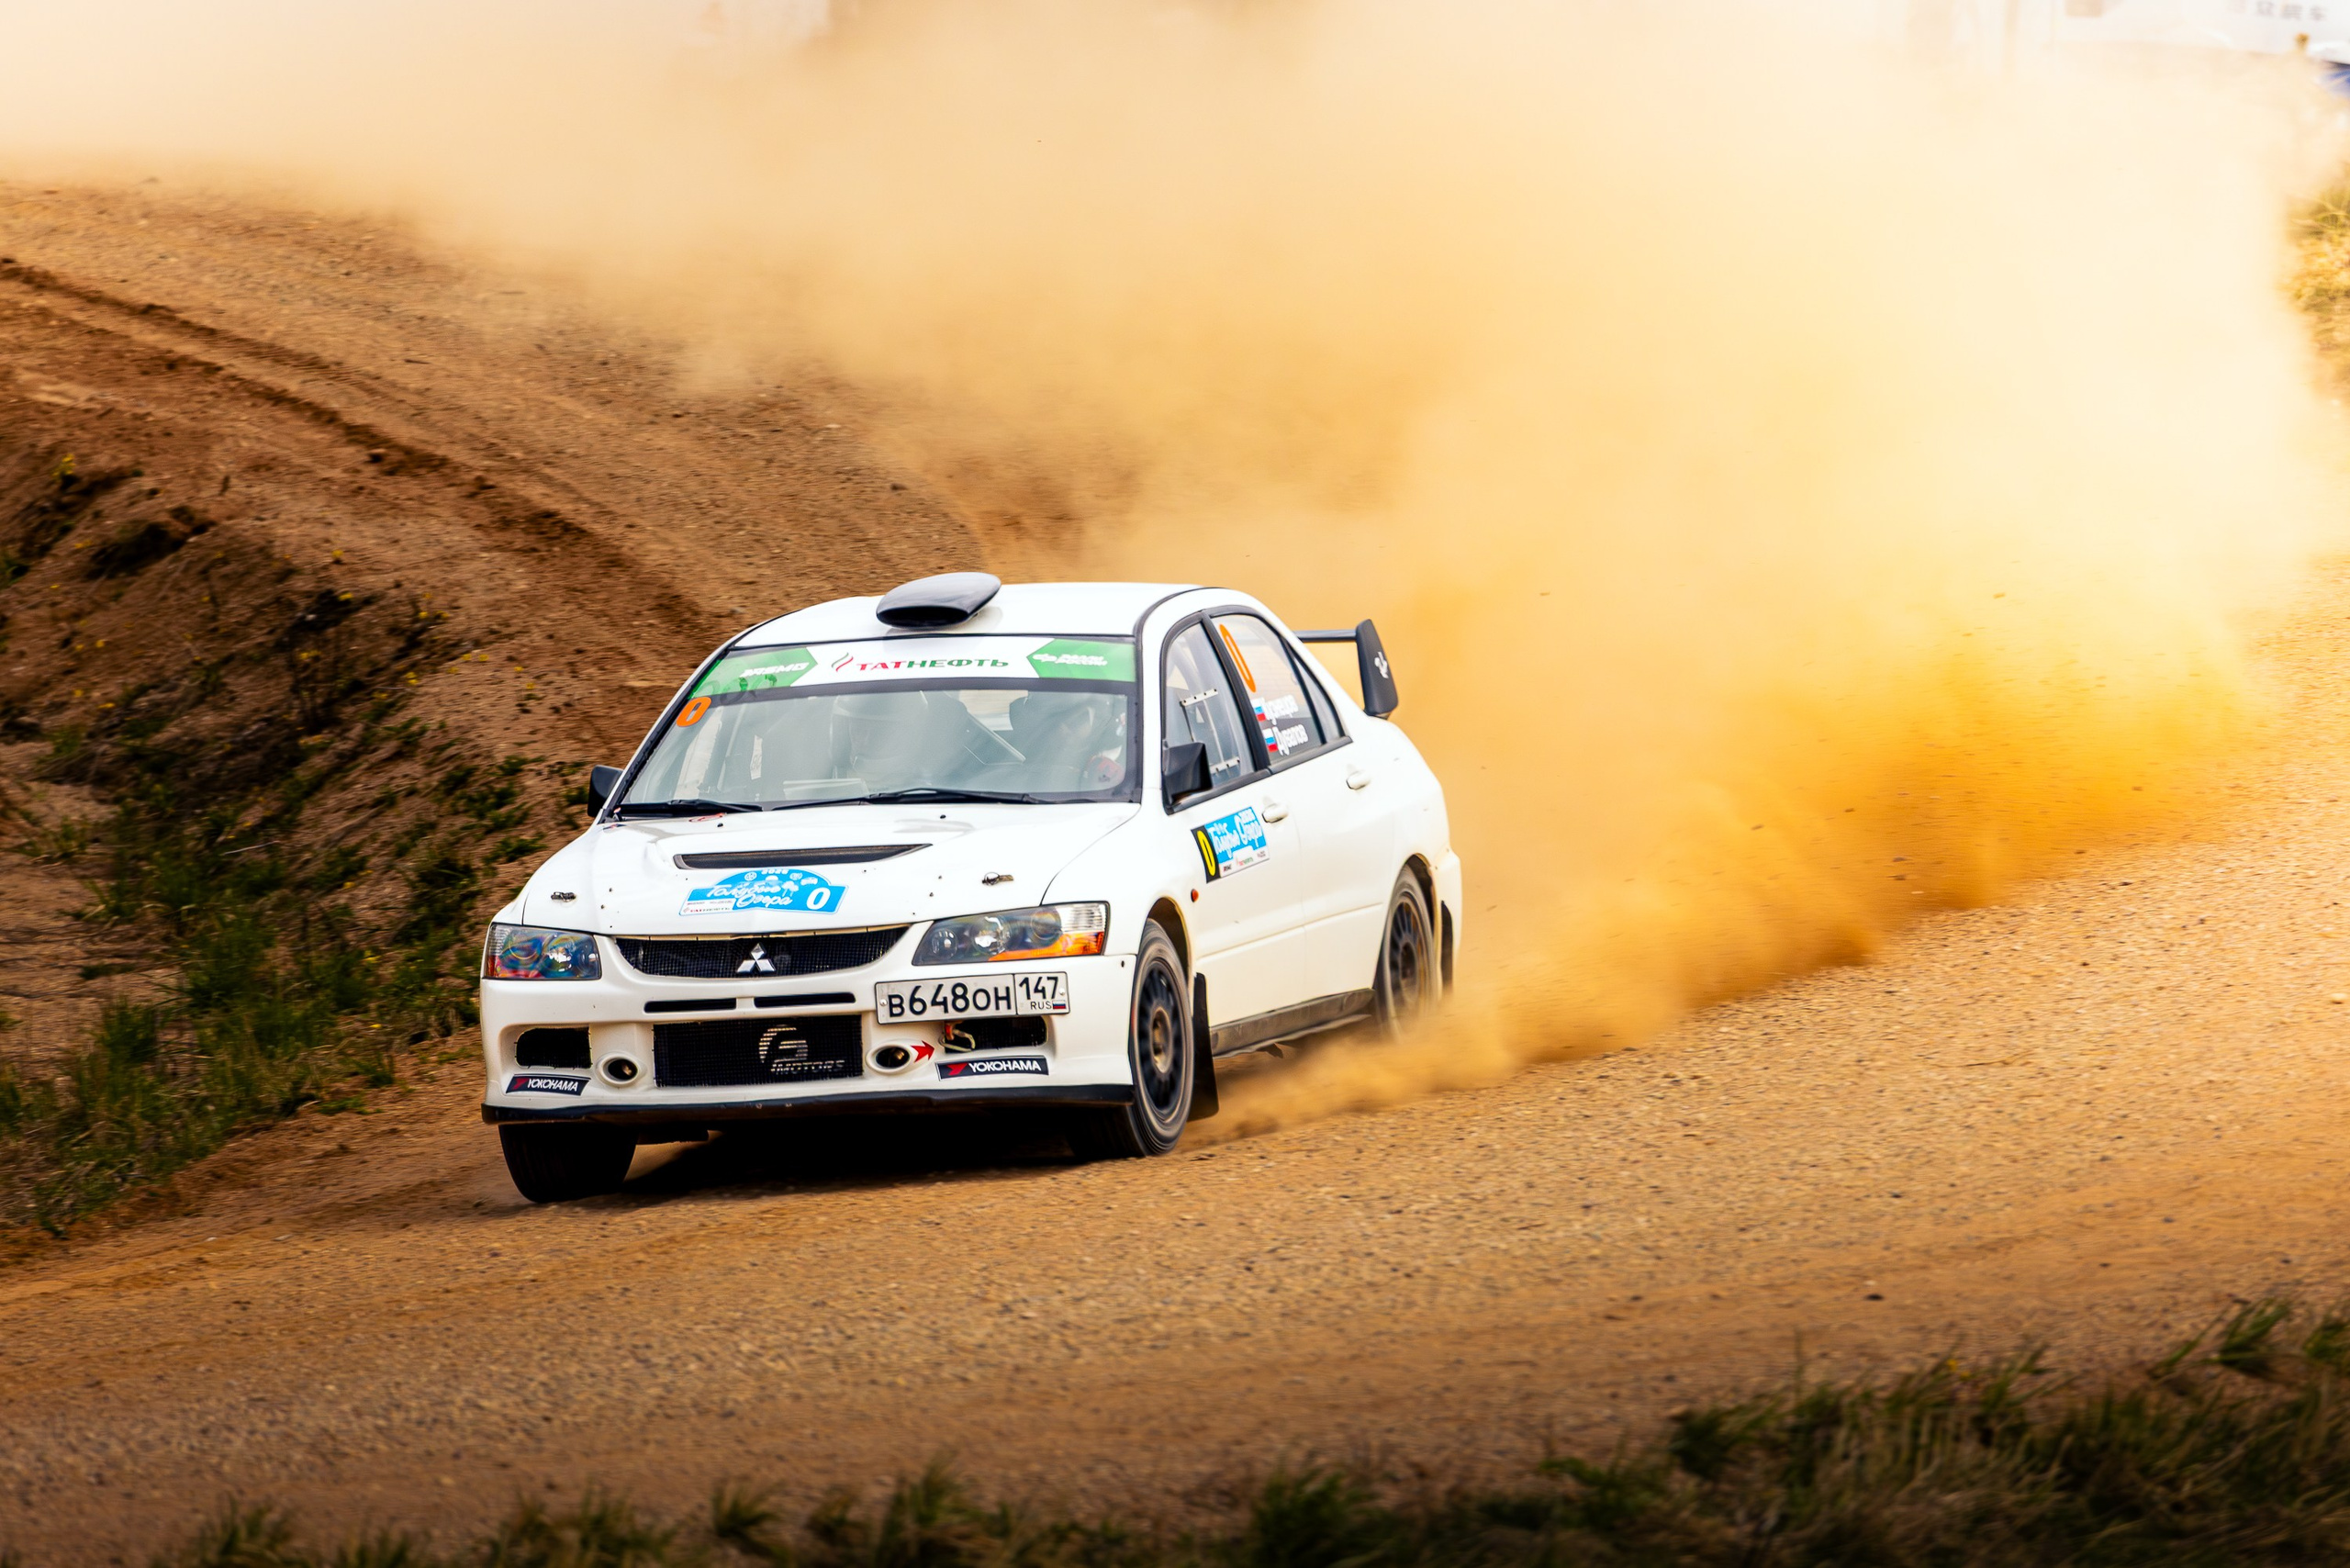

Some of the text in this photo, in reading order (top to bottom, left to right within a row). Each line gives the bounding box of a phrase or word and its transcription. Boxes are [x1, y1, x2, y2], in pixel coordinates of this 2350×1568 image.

[856, 659, 1009, 671] ТАТНЕФТЬ
[676, 696, 712, 727] 0
[1197, 830, 1216, 877] 0
[806, 887, 831, 910] 0
[1019, 976, 1059, 1001] 147
[1031, 1001, 1052, 1011] RUS
[968, 1060, 1042, 1072] YOKOHAMA
[527, 1078, 578, 1092] YOKOHAMA
